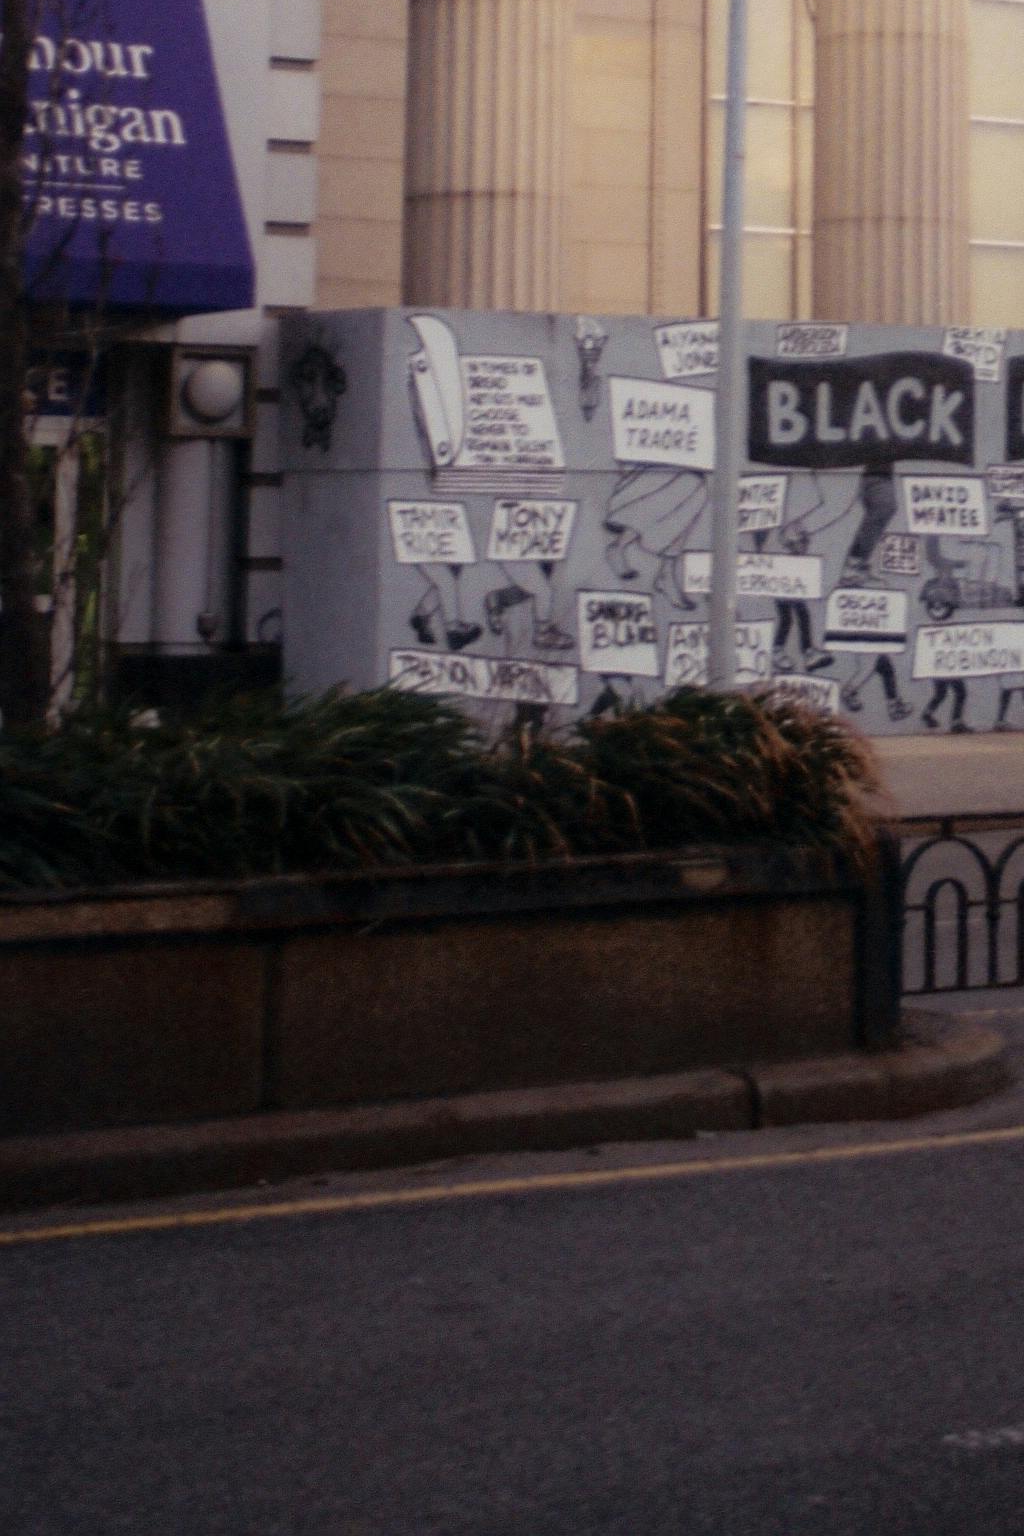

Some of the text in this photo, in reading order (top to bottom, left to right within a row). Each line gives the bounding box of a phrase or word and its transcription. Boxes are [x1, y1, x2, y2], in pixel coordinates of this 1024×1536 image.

[622, 396, 693, 423] ADAMA
[766, 375, 965, 446] BLACK
[625, 424, 699, 453] TRAORÉ
[911, 485, 969, 504] DAVID
[397, 508, 462, 531] TAMIR
[500, 501, 567, 532] TONY
[400, 531, 459, 556] RICE
[836, 594, 889, 611] OSCAR
[924, 627, 994, 648] TAMON
[932, 649, 1022, 672] ROBINSON
